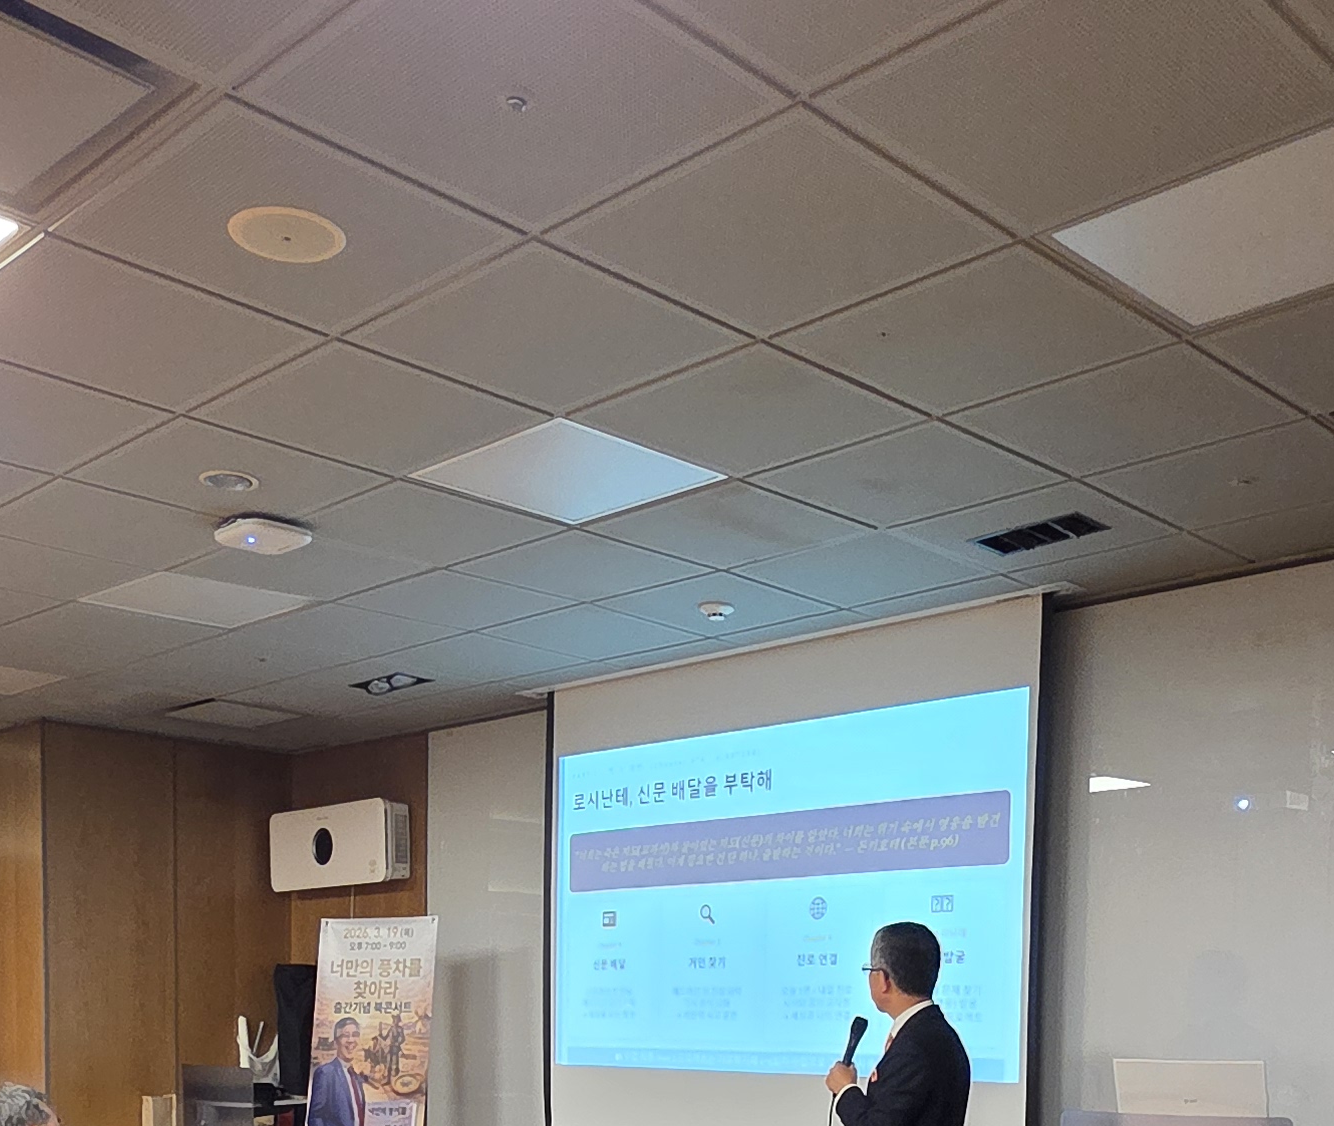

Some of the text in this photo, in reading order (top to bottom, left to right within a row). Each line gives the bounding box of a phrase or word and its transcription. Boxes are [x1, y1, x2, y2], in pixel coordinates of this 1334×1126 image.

[572, 768, 773, 812] 로시난테, 신문 배달을 부탁해
[976, 811, 1001, 829] 발견
[330, 957, 423, 978] 너만의 풍차를
[797, 952, 838, 967] 진로 연결
[353, 979, 399, 1000] 찾아라
[333, 1001, 413, 1015] 출간기념 북콘서트
